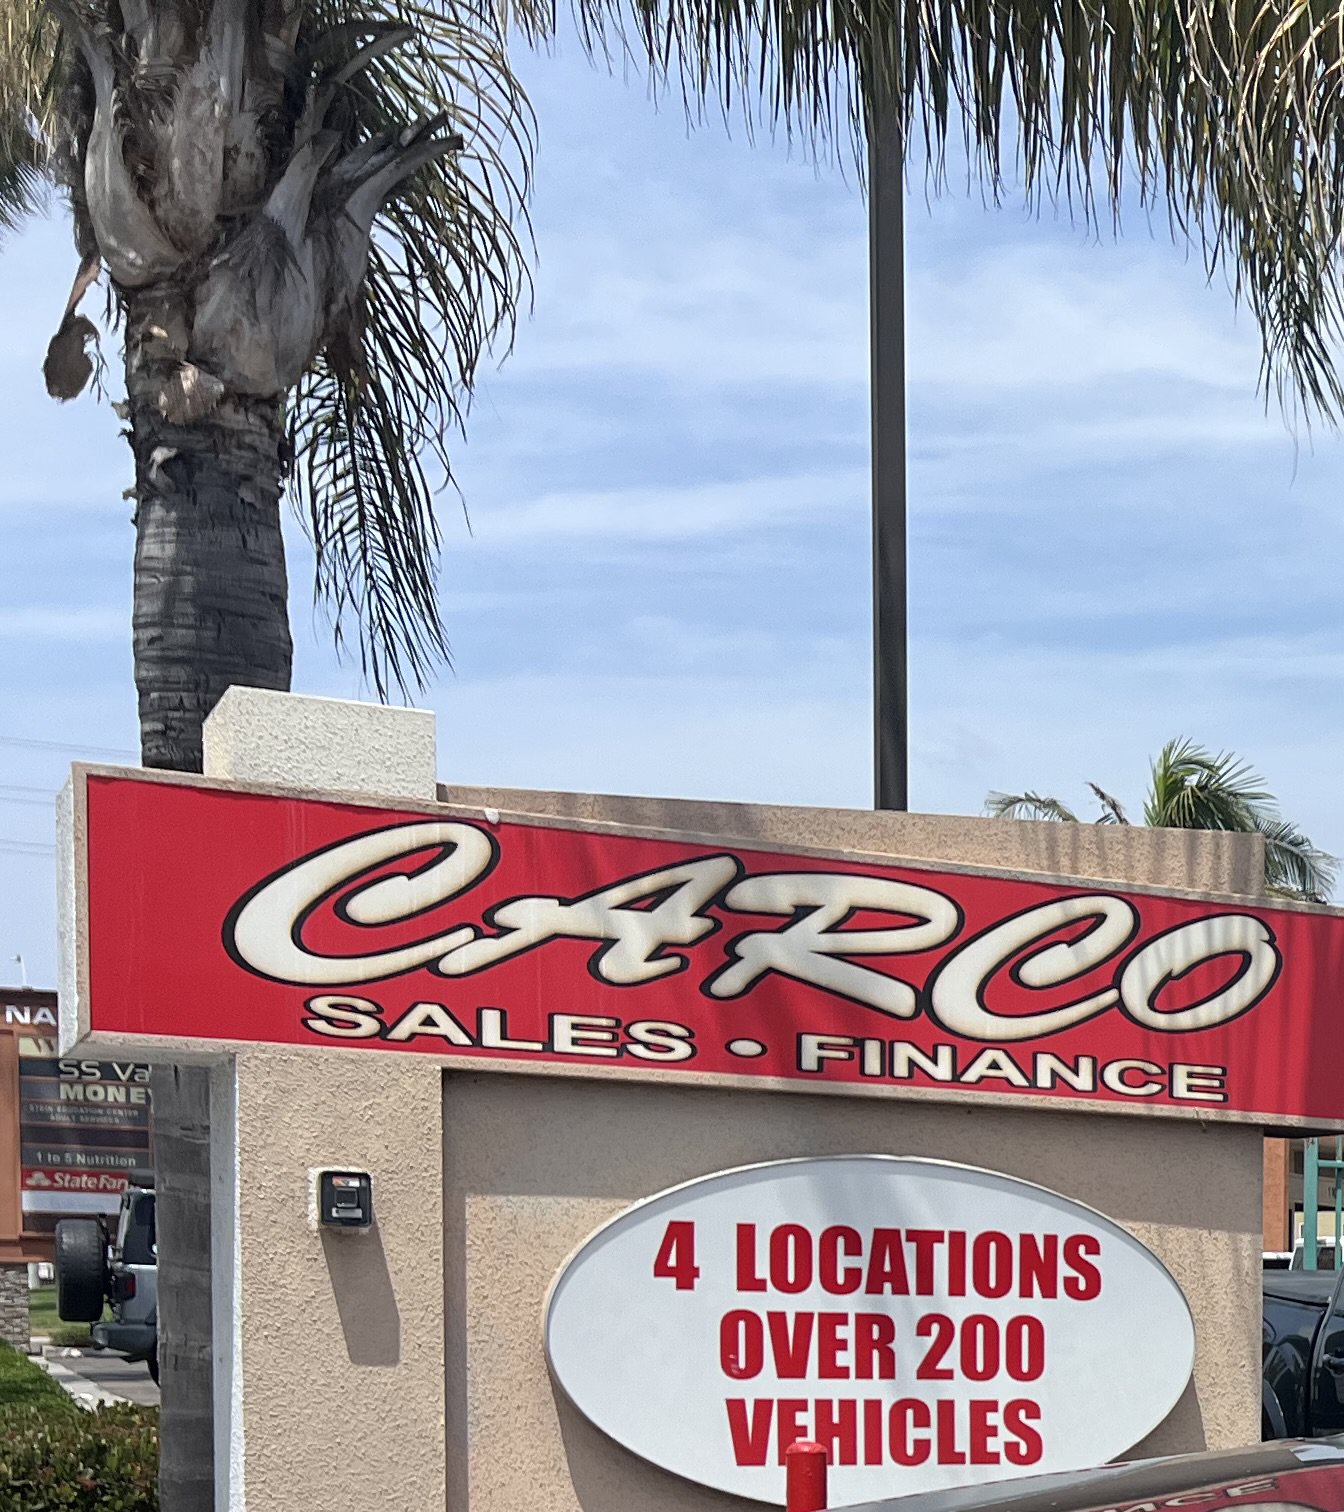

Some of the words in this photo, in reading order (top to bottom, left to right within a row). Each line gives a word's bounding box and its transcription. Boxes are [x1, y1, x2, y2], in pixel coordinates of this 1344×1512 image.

[222, 818, 1283, 1042] CARCO
[303, 995, 695, 1063] SALES
[797, 1031, 1230, 1103] FINANCE
[53, 1172, 97, 1189] State
[76, 1153, 136, 1166] Nutrition
[653, 1220, 700, 1291] 4
[735, 1223, 1102, 1300] LOCATIONS
[719, 1309, 896, 1380] OVER
[915, 1313, 1045, 1382] 200
[725, 1397, 1044, 1467] VEHICLES
